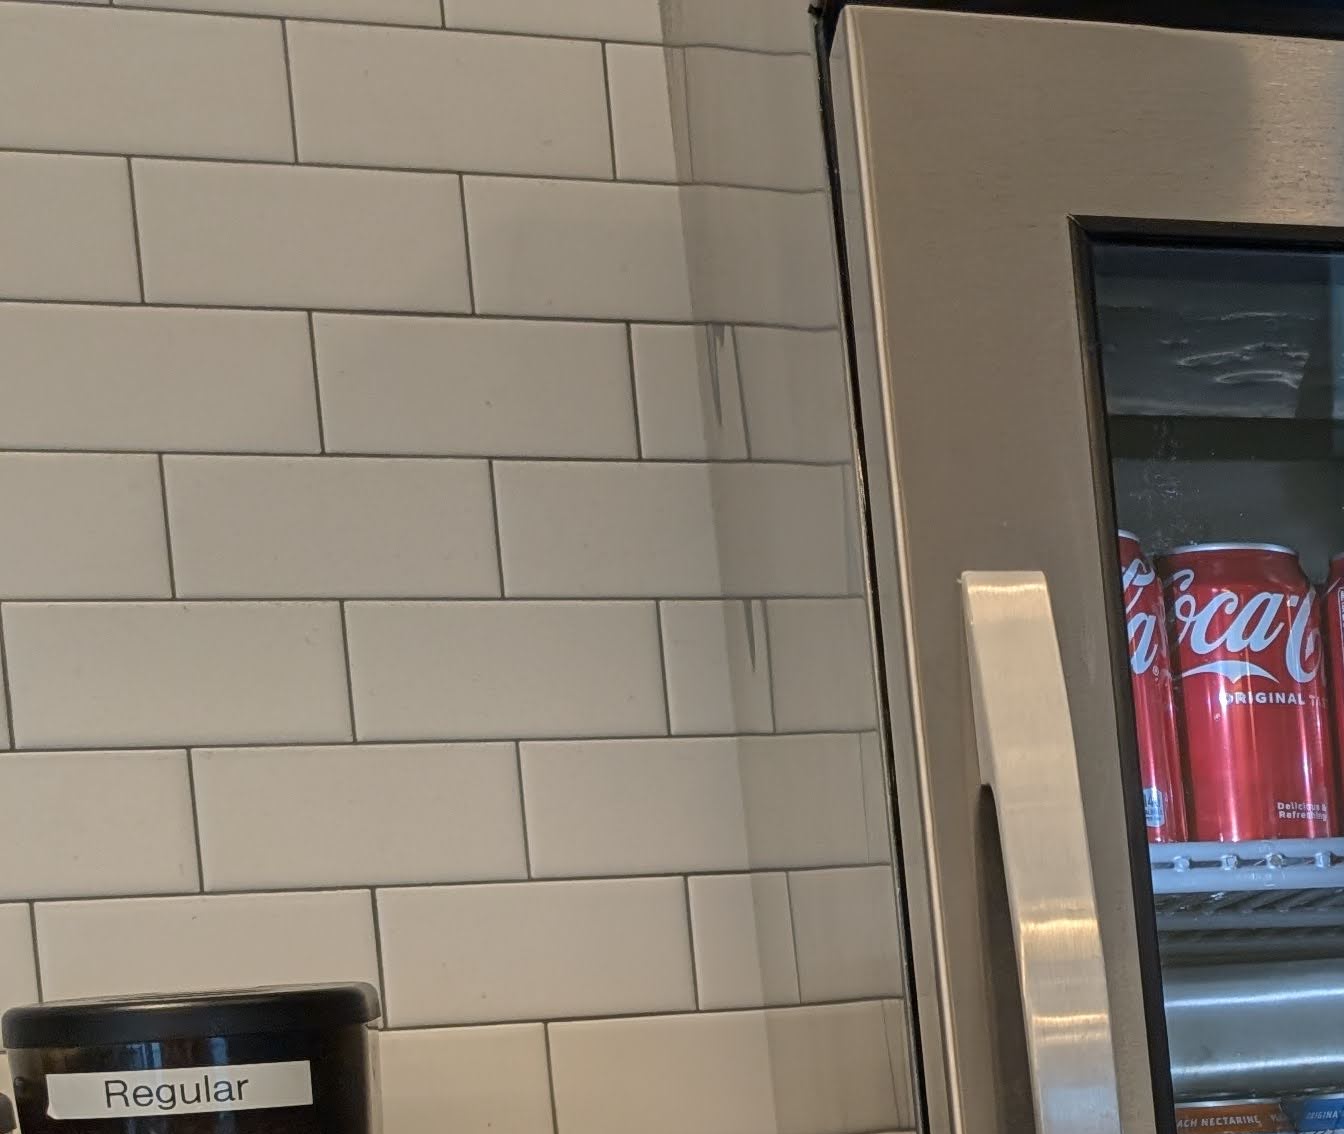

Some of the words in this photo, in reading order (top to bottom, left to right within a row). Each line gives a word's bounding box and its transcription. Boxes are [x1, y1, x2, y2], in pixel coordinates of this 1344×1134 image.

[1220, 692, 1305, 705] ORIGINAL
[104, 1075, 249, 1110] Regular
[1200, 1115, 1261, 1126] NECTARINE
